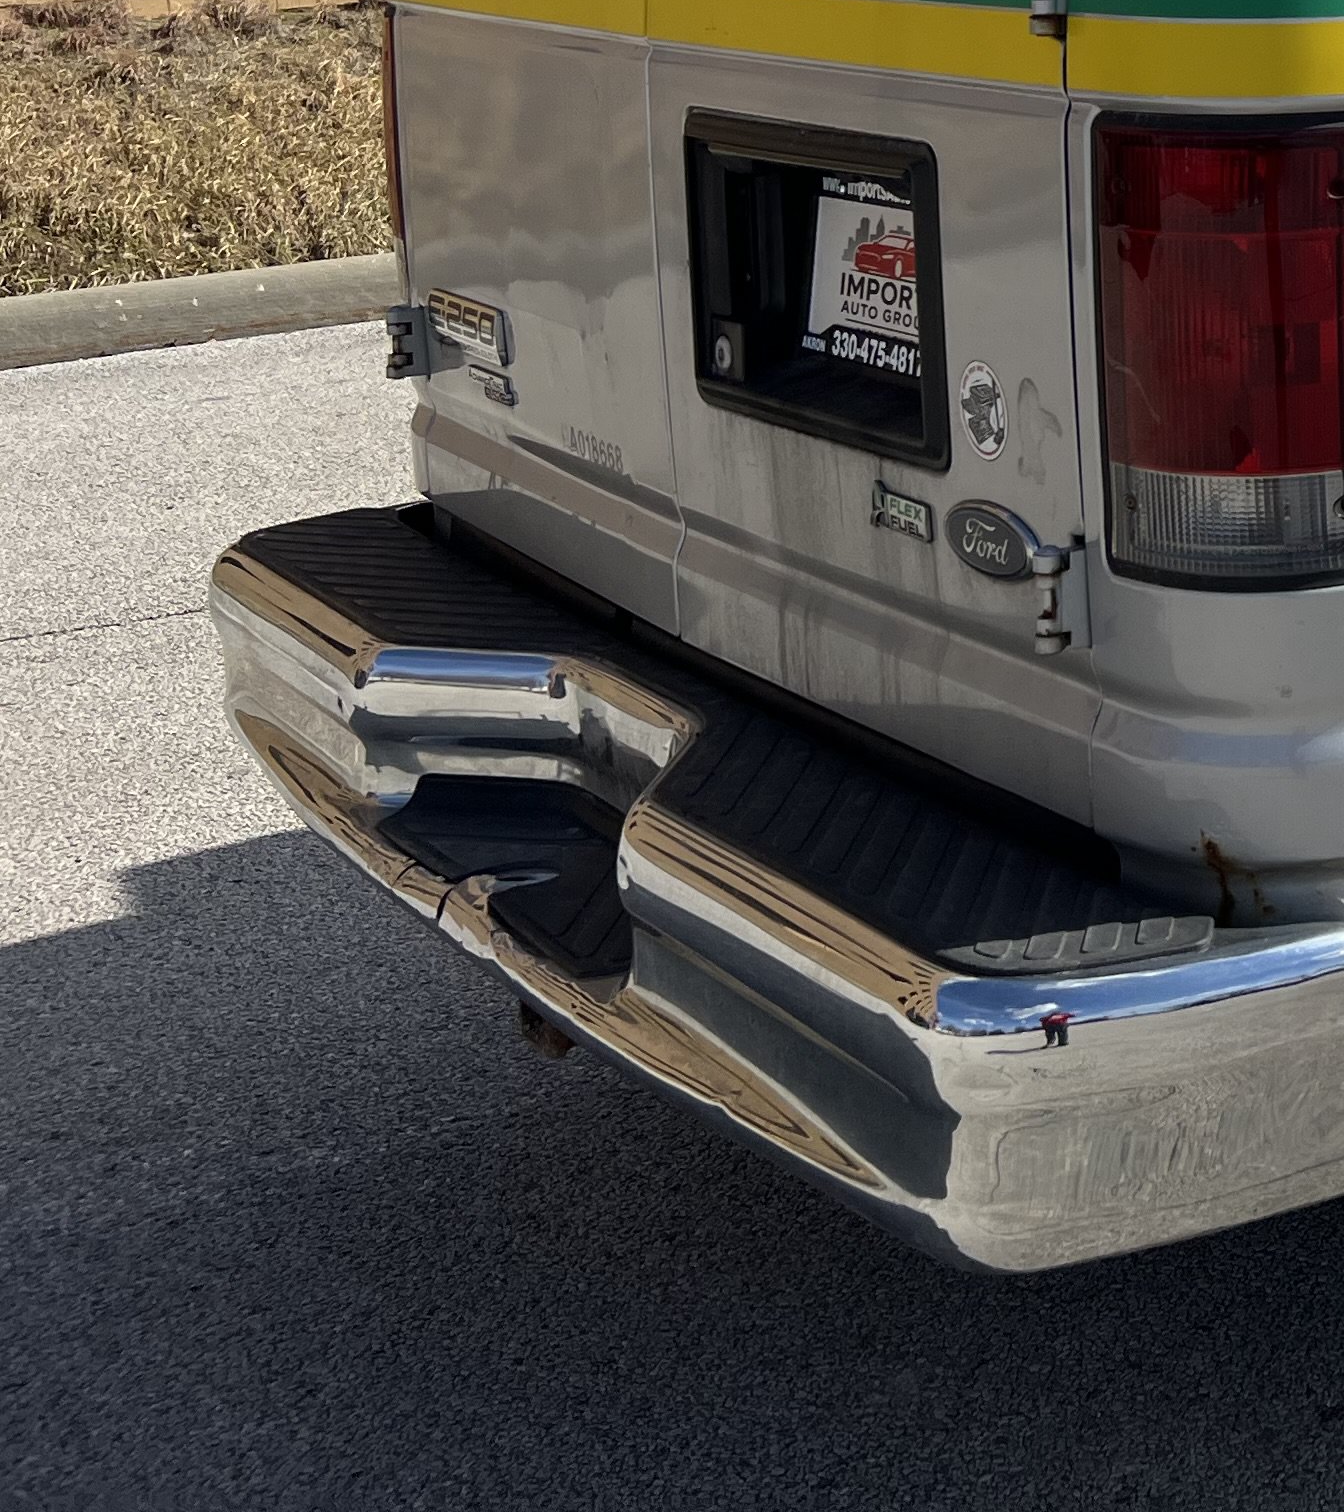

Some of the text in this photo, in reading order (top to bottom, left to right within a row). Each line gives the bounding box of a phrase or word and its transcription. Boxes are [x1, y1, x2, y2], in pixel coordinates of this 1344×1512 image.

[840, 272, 919, 311] IMPOR
[840, 299, 878, 321] AUTO
[802, 335, 826, 354] AKRON
[890, 497, 924, 522] FLEX
[890, 516, 924, 539] FUEL
[962, 518, 1009, 565] Ford
